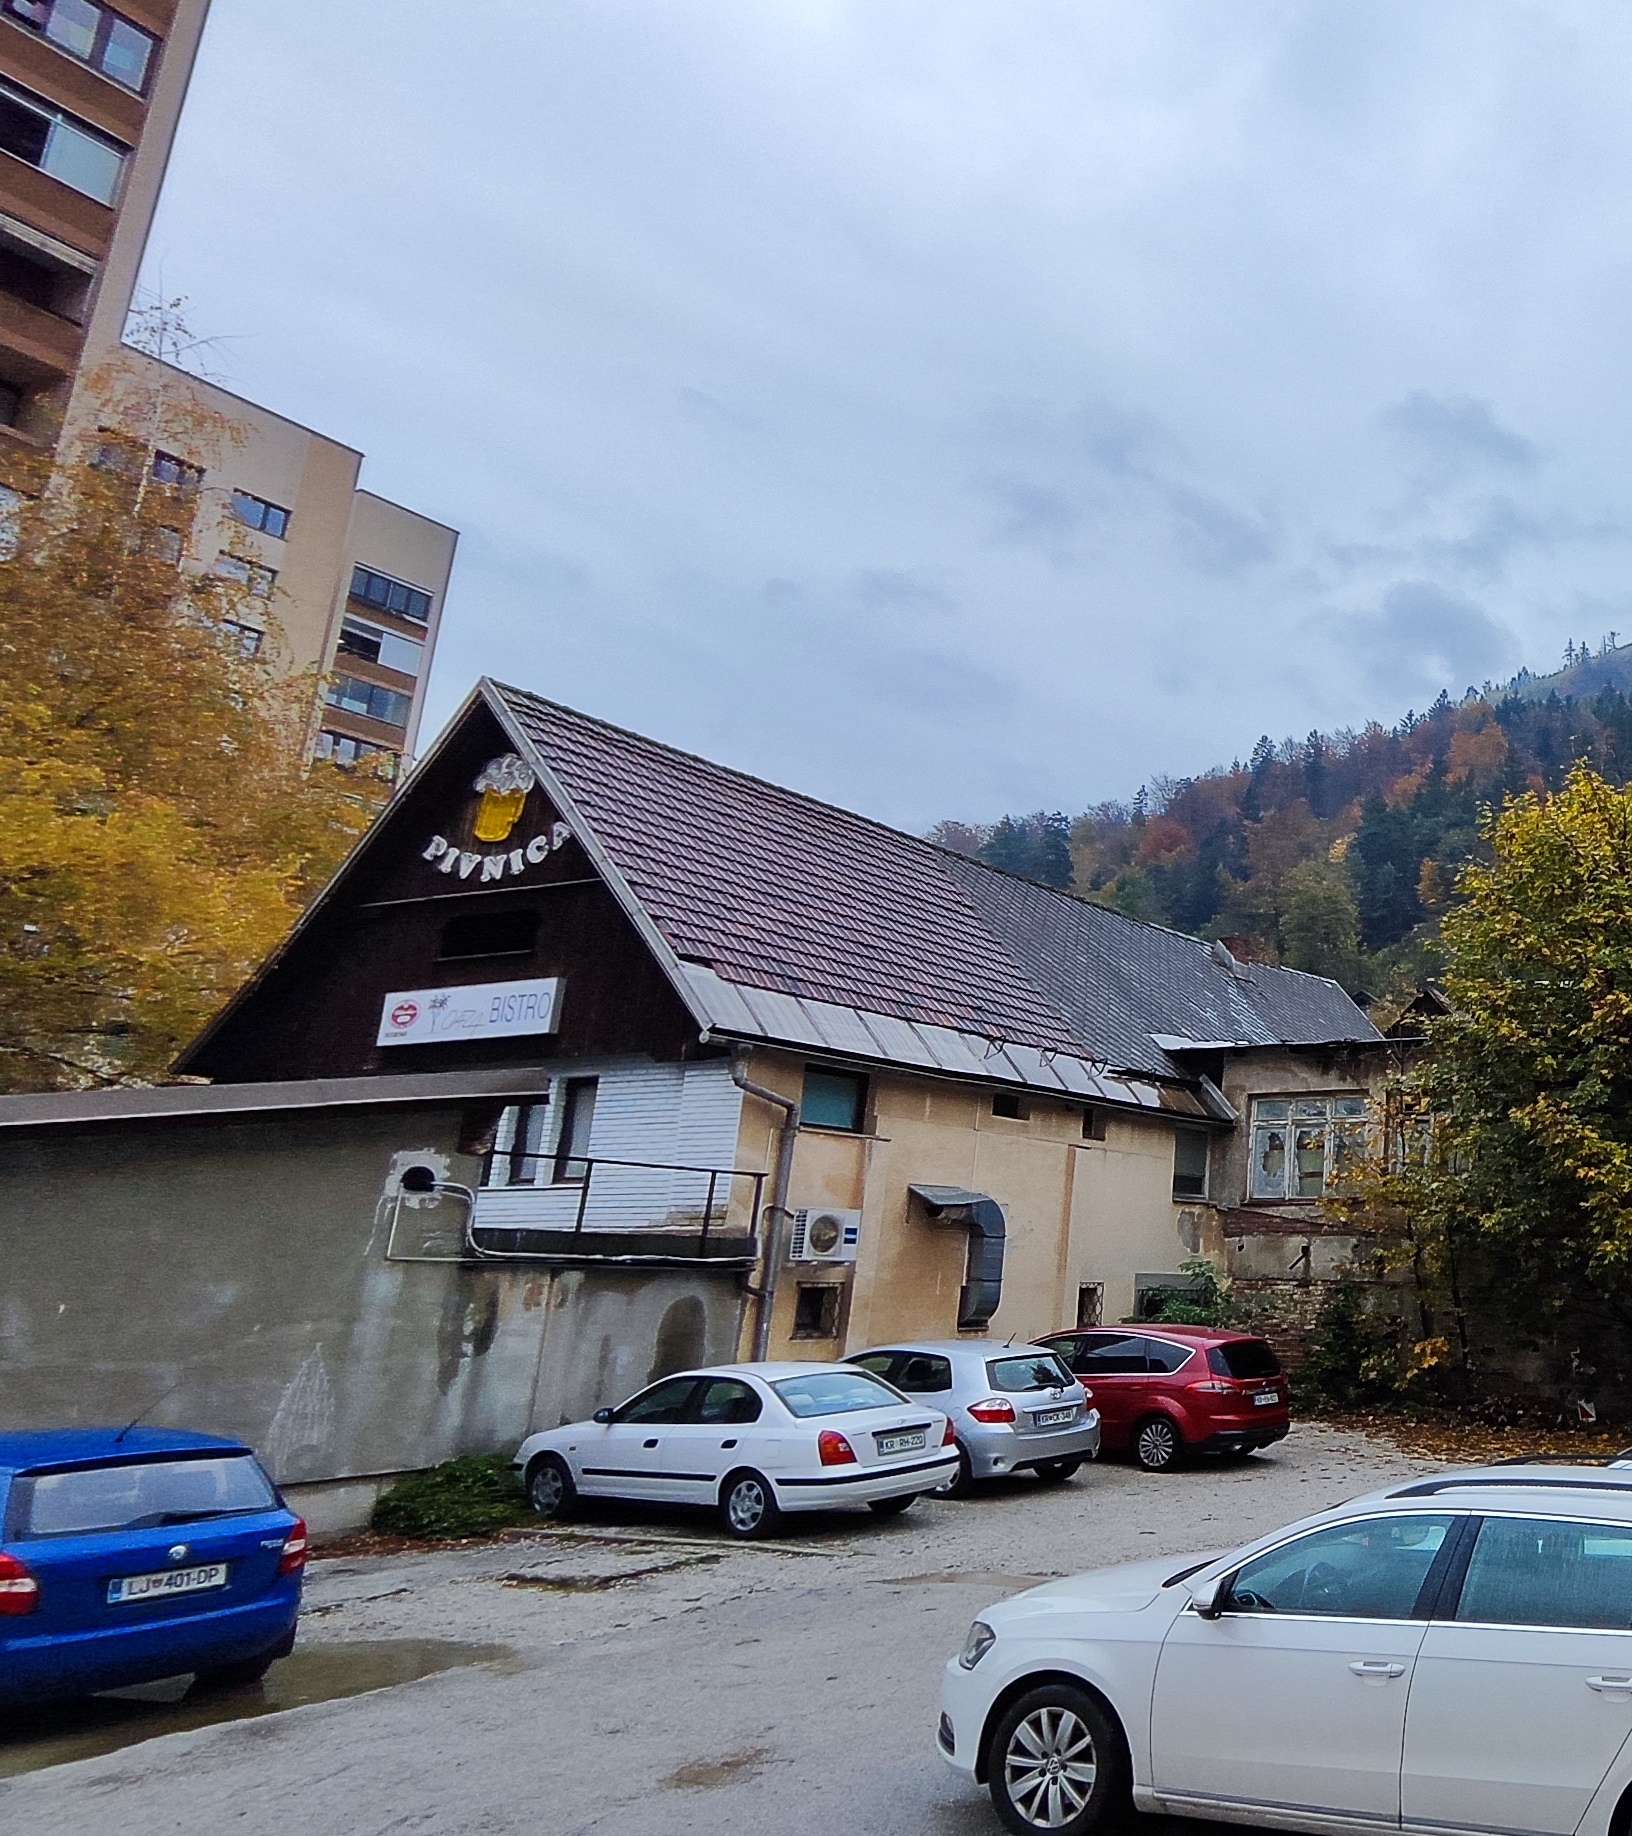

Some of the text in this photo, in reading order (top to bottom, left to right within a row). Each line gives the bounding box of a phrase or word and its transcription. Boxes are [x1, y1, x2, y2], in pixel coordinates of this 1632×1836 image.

[422, 821, 571, 882] PIVNICA
[489, 992, 550, 1023] BISTRO
[885, 1435, 923, 1450] KR RH-220
[127, 1567, 219, 1595] LJ 401-DP
